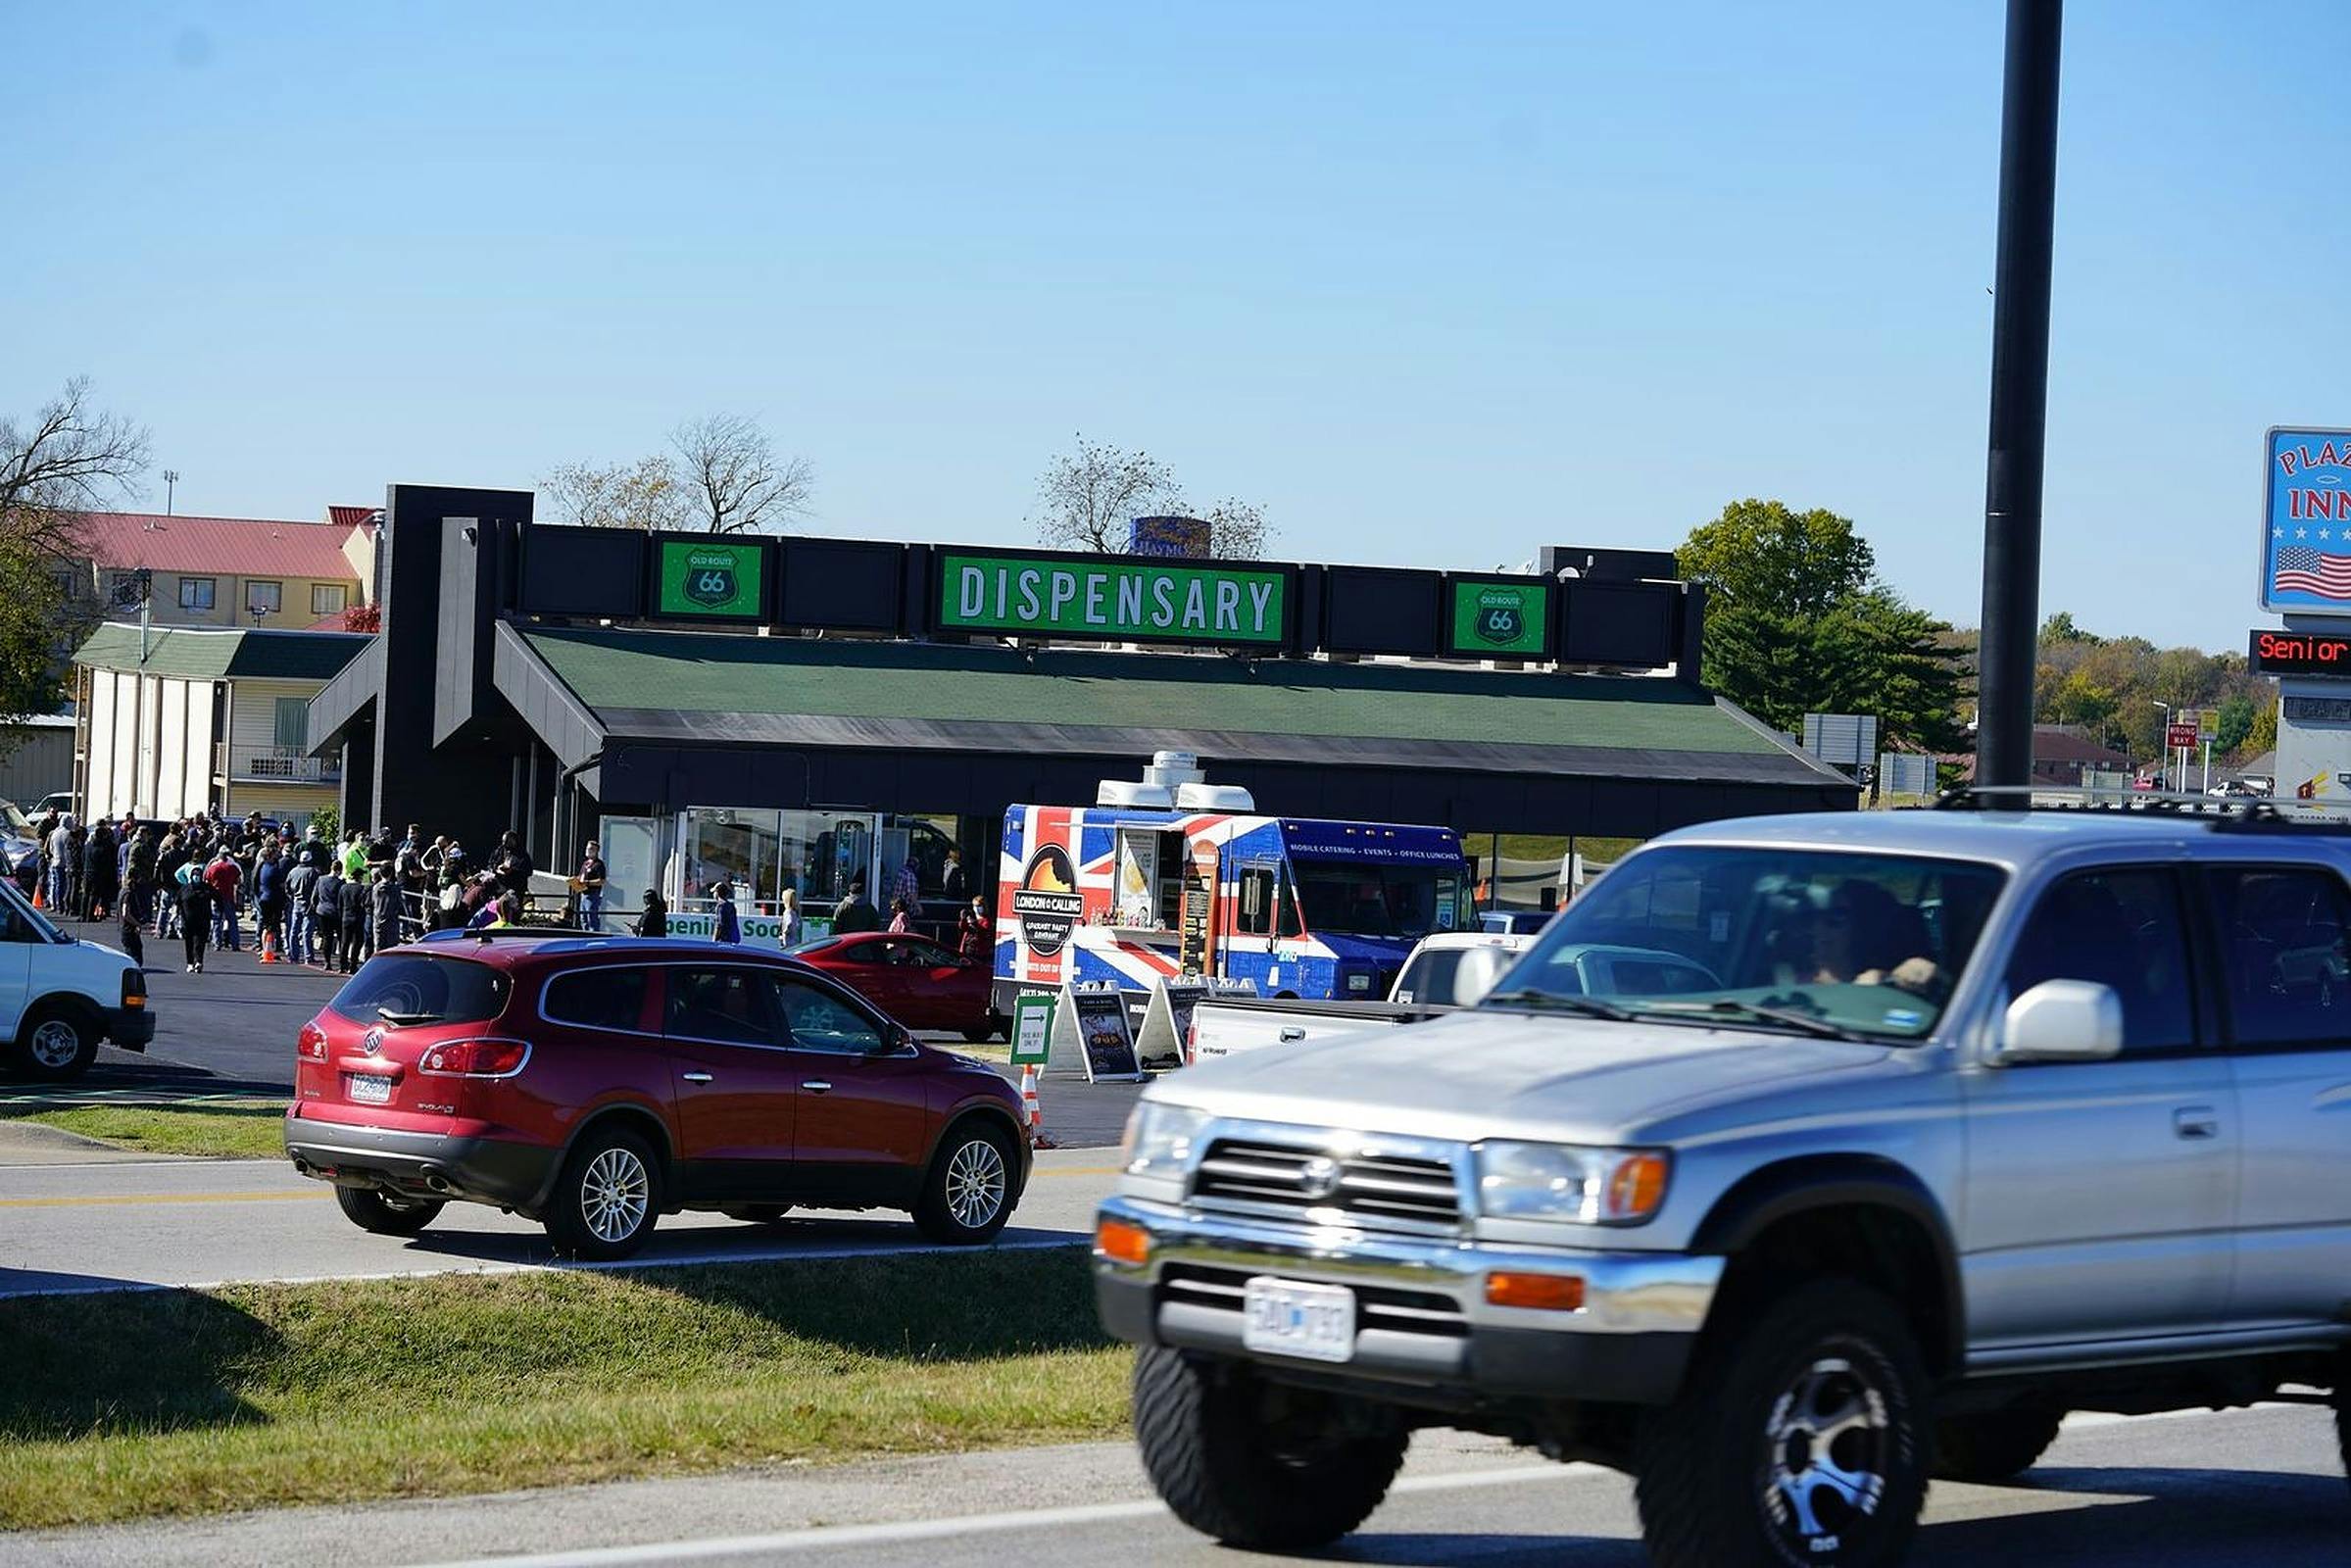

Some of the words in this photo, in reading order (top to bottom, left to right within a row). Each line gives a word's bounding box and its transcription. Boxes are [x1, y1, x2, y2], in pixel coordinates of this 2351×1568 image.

[2288, 488, 2351, 520] INN
[691, 556, 707, 564] OLD
[699, 571, 725, 592] 66
[959, 565, 1273, 632] DISPENSARY
[1489, 611, 1513, 630] 66
[2259, 635, 2349, 661] Senior
[2170, 726, 2195, 736] WRONG
[1290, 844, 1319, 853] MOBILE
[1320, 845, 1355, 855] CATERING
[1363, 848, 1393, 857] EVENTS
[1399, 850, 1425, 858] OFFICE
[1426, 852, 1460, 860] LUNCHES
[1015, 896, 1046, 909] LONDON
[1052, 899, 1081, 911] CALLING
[743, 919, 782, 938] Soo
